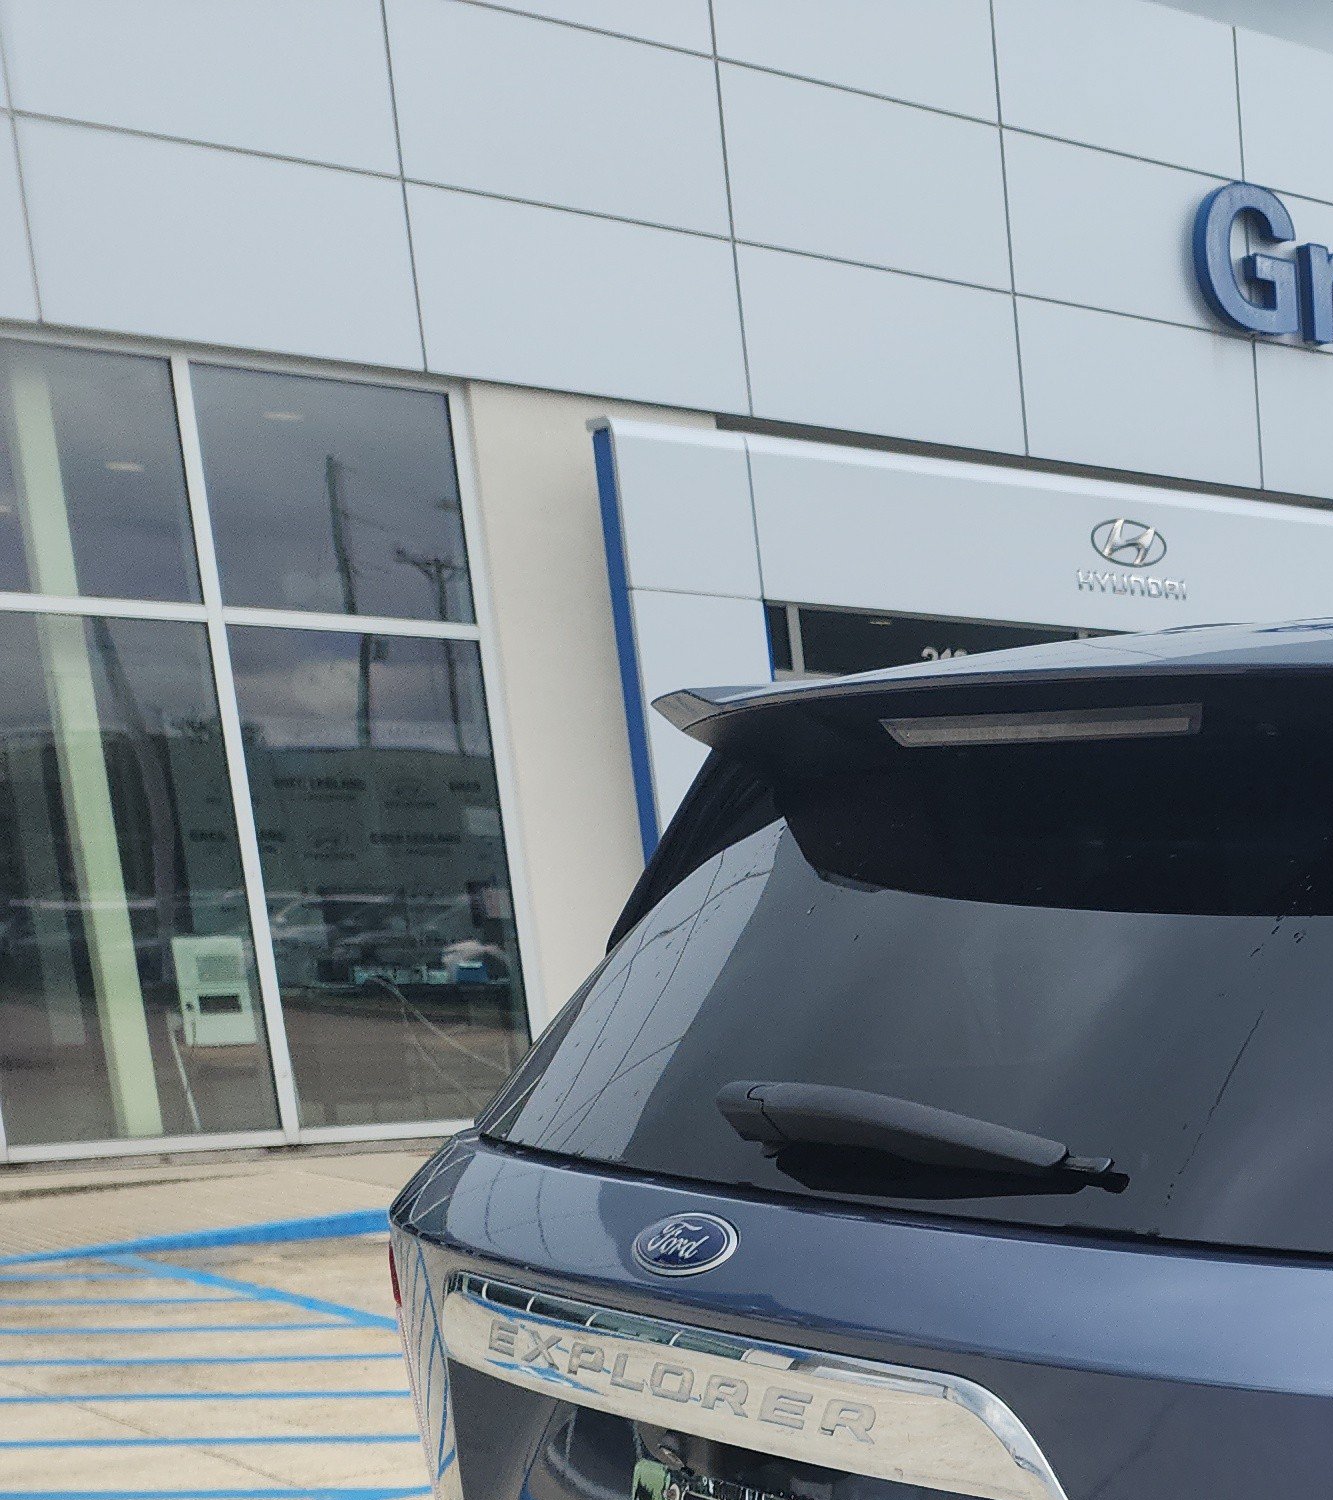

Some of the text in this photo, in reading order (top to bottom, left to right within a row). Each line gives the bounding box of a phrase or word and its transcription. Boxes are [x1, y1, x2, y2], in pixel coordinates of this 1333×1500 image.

[1077, 569, 1187, 600] HYUNDAI
[646, 1220, 710, 1260] Ford
[487, 1318, 876, 1445] EXPLORER
